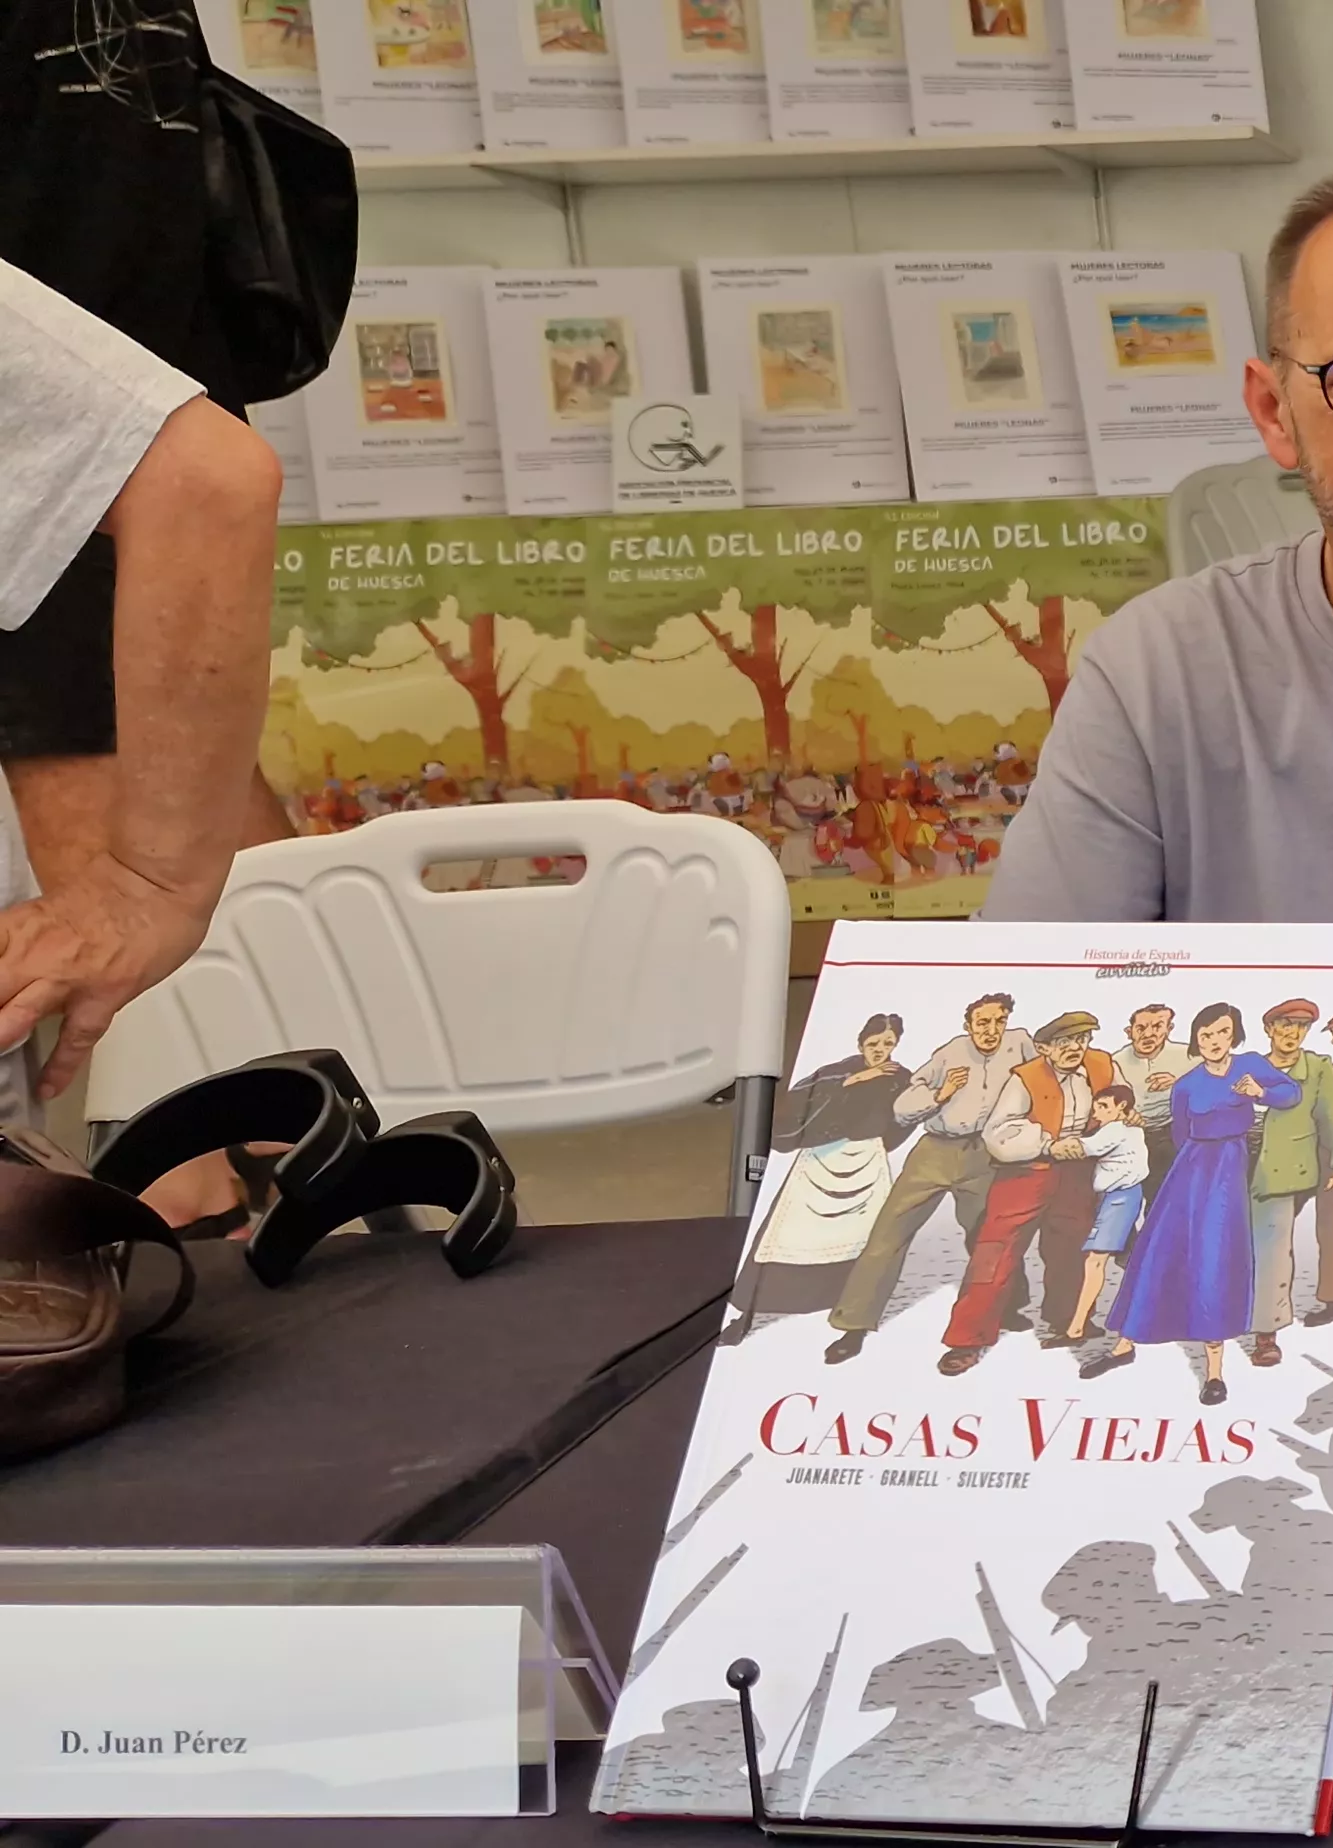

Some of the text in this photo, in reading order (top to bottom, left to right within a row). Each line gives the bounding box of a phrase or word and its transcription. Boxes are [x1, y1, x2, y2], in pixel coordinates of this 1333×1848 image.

[609, 530, 863, 561] FERIA DEL LIBRO
[895, 521, 1148, 552] FERIA DEL LIBRO
[329, 542, 413, 569] FERIA
[426, 541, 484, 566] DEL
[498, 540, 586, 564] LIBRO
[894, 556, 993, 573] DE HUESCA
[328, 574, 425, 591] DE HUESCA
[608, 565, 707, 583] DE HUESCA
[1084, 949, 1191, 962] Historia de España
[759, 1392, 1257, 1464] CASAS VIEJAS
[786, 1467, 1031, 1490] JUANARETE GRANELL SILVESTRE
[60, 1728, 248, 1755] D. Juan Pérez
